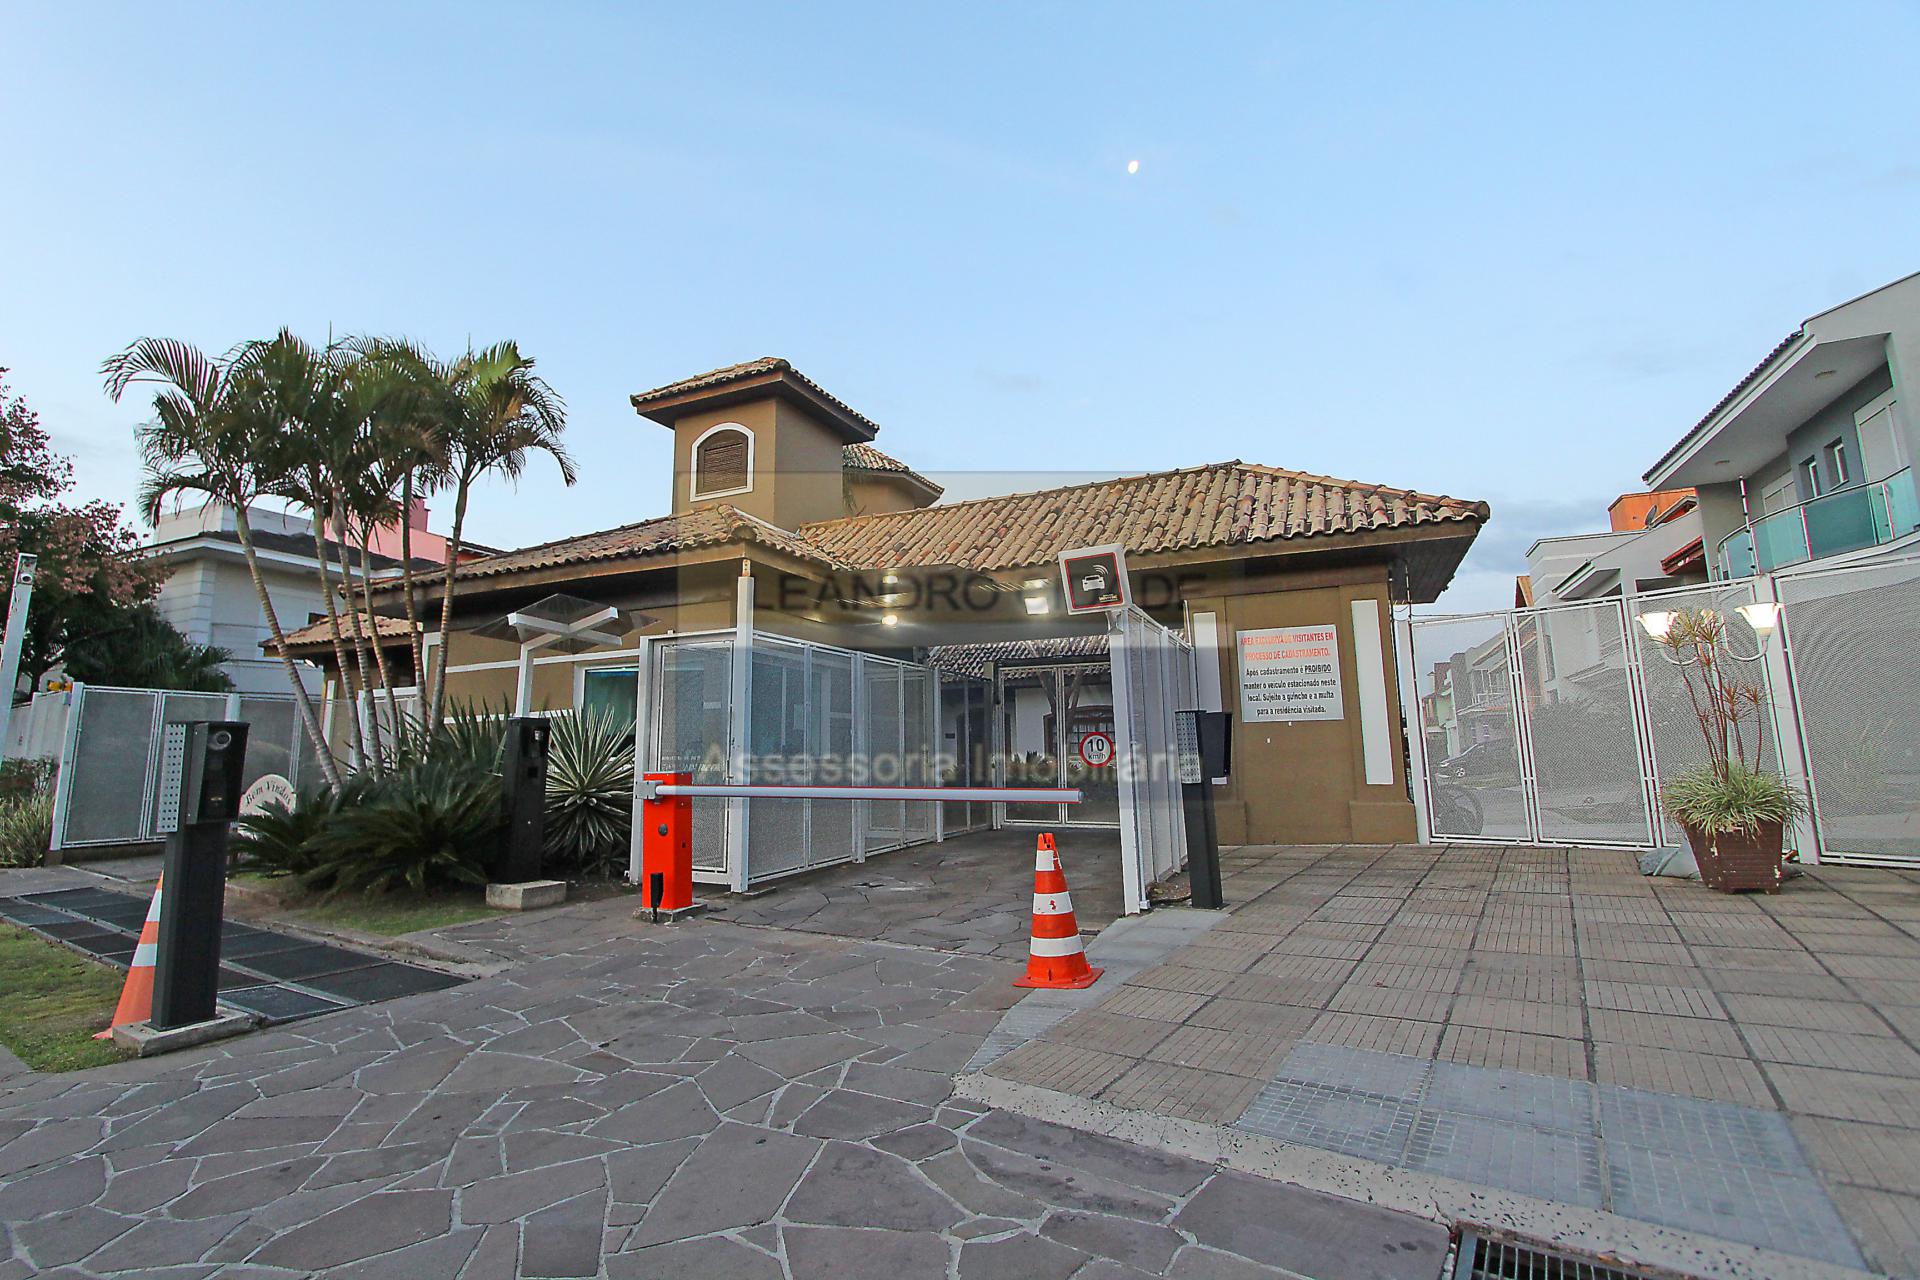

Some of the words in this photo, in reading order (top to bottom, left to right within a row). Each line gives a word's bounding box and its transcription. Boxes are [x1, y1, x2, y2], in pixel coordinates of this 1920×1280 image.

[1293, 632, 1324, 643] VISITANTES
[1325, 631, 1333, 641] EM
[1245, 651, 1272, 661] PROCESSO
[1274, 650, 1280, 660] DE
[1260, 667, 1299, 676] cadastramento
[1304, 663, 1332, 674] PROIBIDO
[1244, 682, 1262, 690] manter
[1287, 679, 1319, 688] estacionado
[1321, 678, 1336, 686] neste
[1263, 693, 1281, 703] Sujeito
[1287, 691, 1308, 702] guincho
[1318, 690, 1334, 699] multa
[1256, 708, 1269, 717] para
[1303, 704, 1327, 714] visitada.
[1087, 738, 1105, 752] 10
